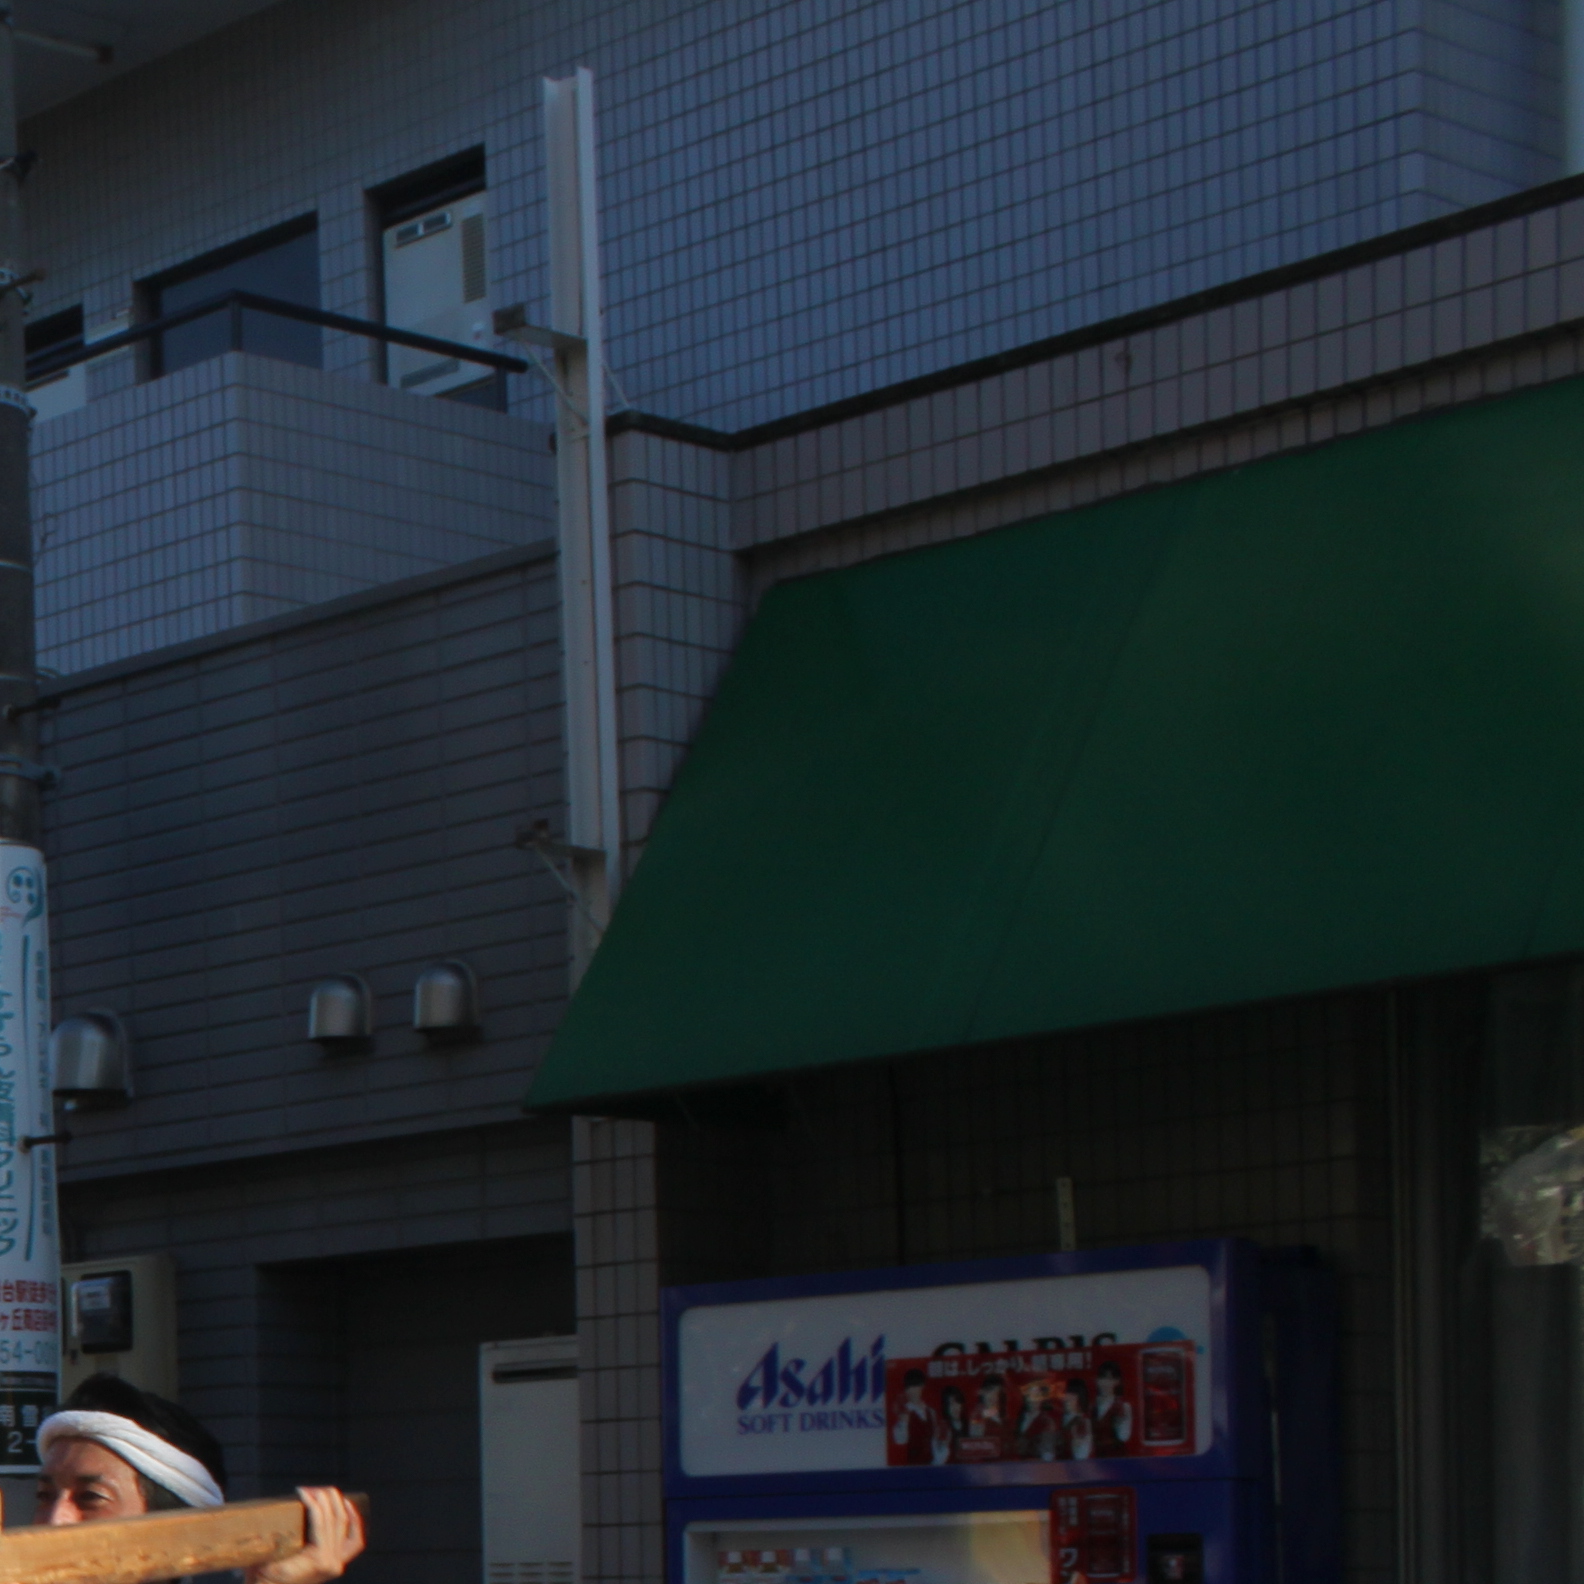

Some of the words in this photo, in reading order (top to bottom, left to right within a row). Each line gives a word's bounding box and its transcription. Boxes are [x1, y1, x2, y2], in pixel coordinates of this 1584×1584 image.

[737, 1334, 886, 1410] Asahi
[737, 1413, 792, 1435] SOFT
[800, 1409, 885, 1431] DRINKS
